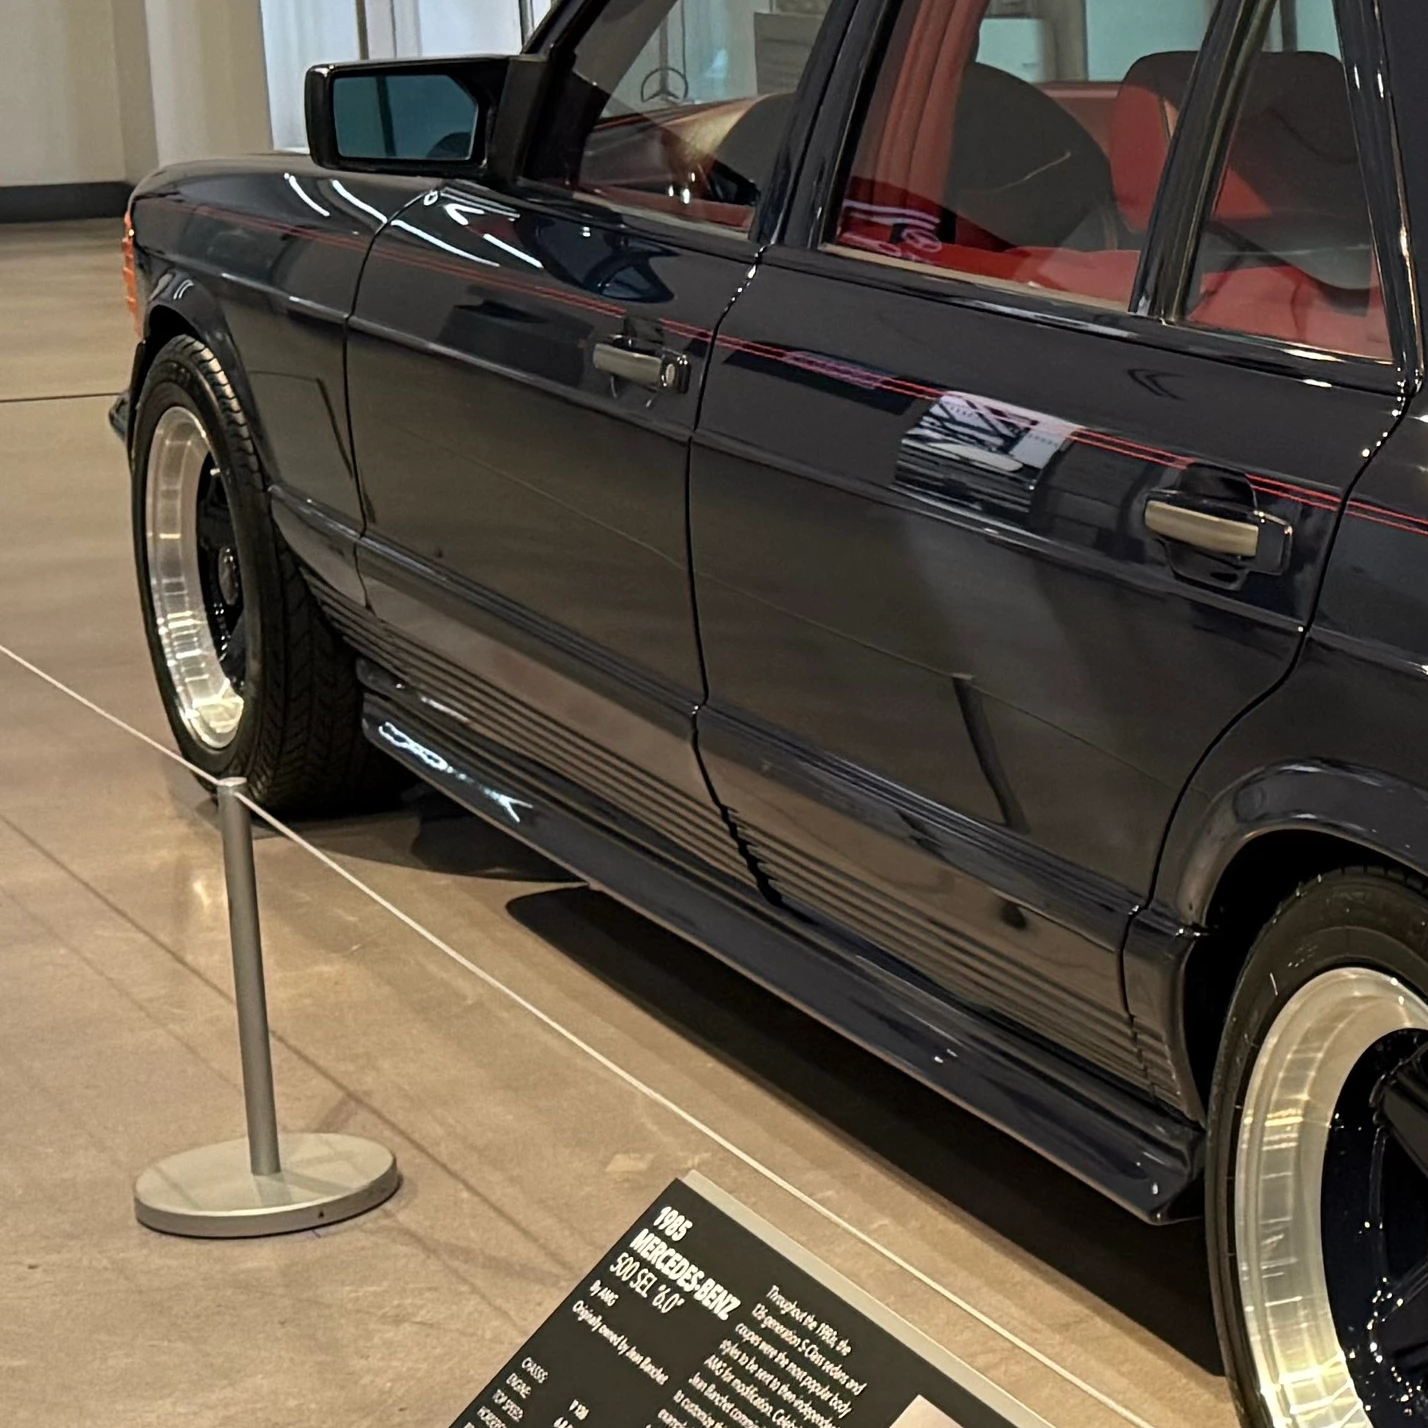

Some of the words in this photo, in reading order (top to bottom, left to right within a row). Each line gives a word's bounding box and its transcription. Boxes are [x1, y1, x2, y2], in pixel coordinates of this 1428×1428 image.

[652, 1205, 694, 1242] 1985
[609, 1251, 641, 1282] 500
[628, 1267, 658, 1299] SEL
[628, 1227, 742, 1321] MERCEDES-BENZ
